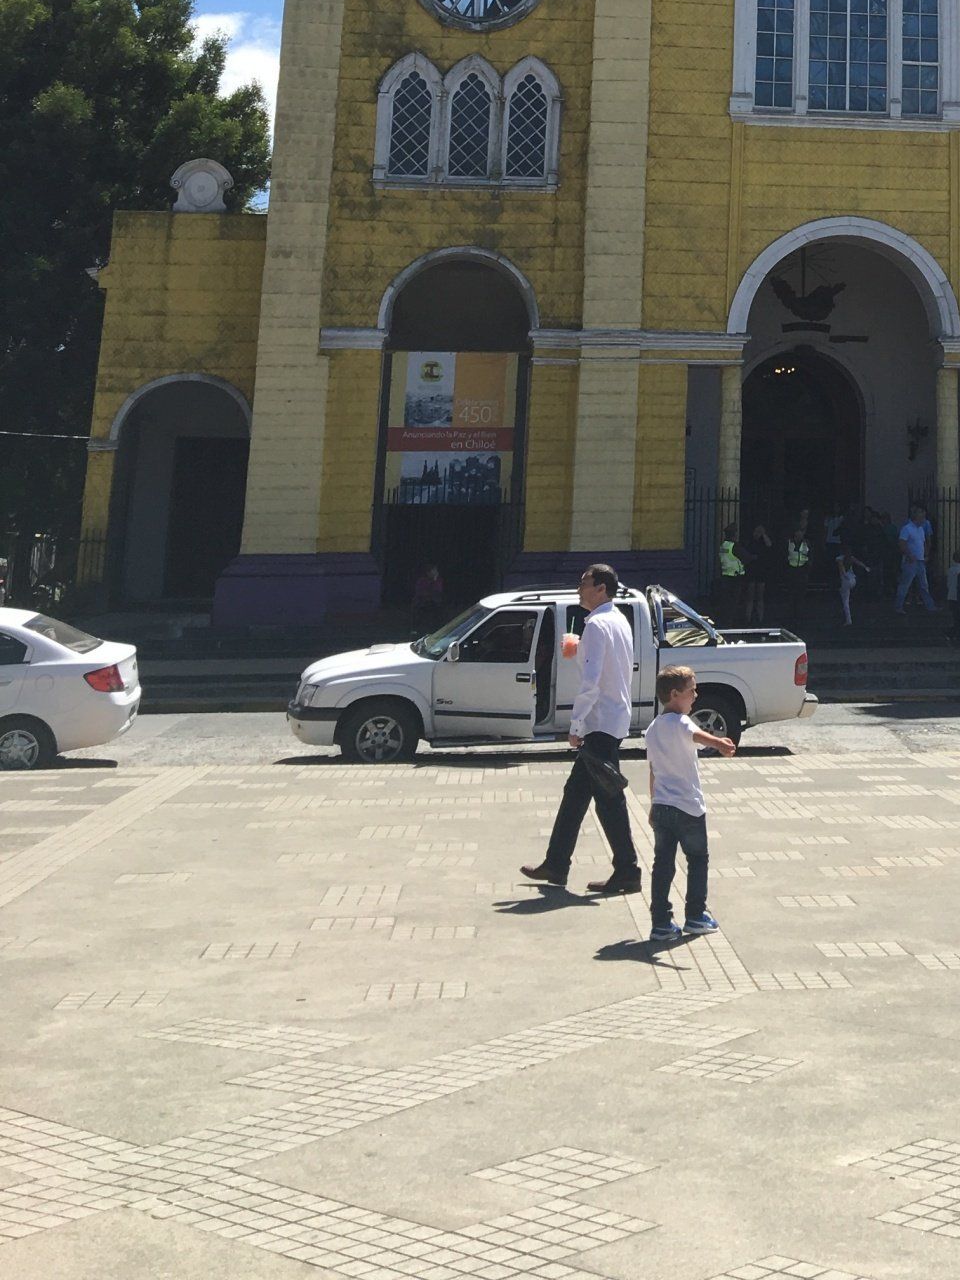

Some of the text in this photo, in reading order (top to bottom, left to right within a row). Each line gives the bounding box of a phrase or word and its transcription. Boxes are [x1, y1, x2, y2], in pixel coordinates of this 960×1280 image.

[459, 406, 492, 423] 450
[402, 431, 445, 439] Anunciando
[451, 439, 497, 449] en Chiloé
